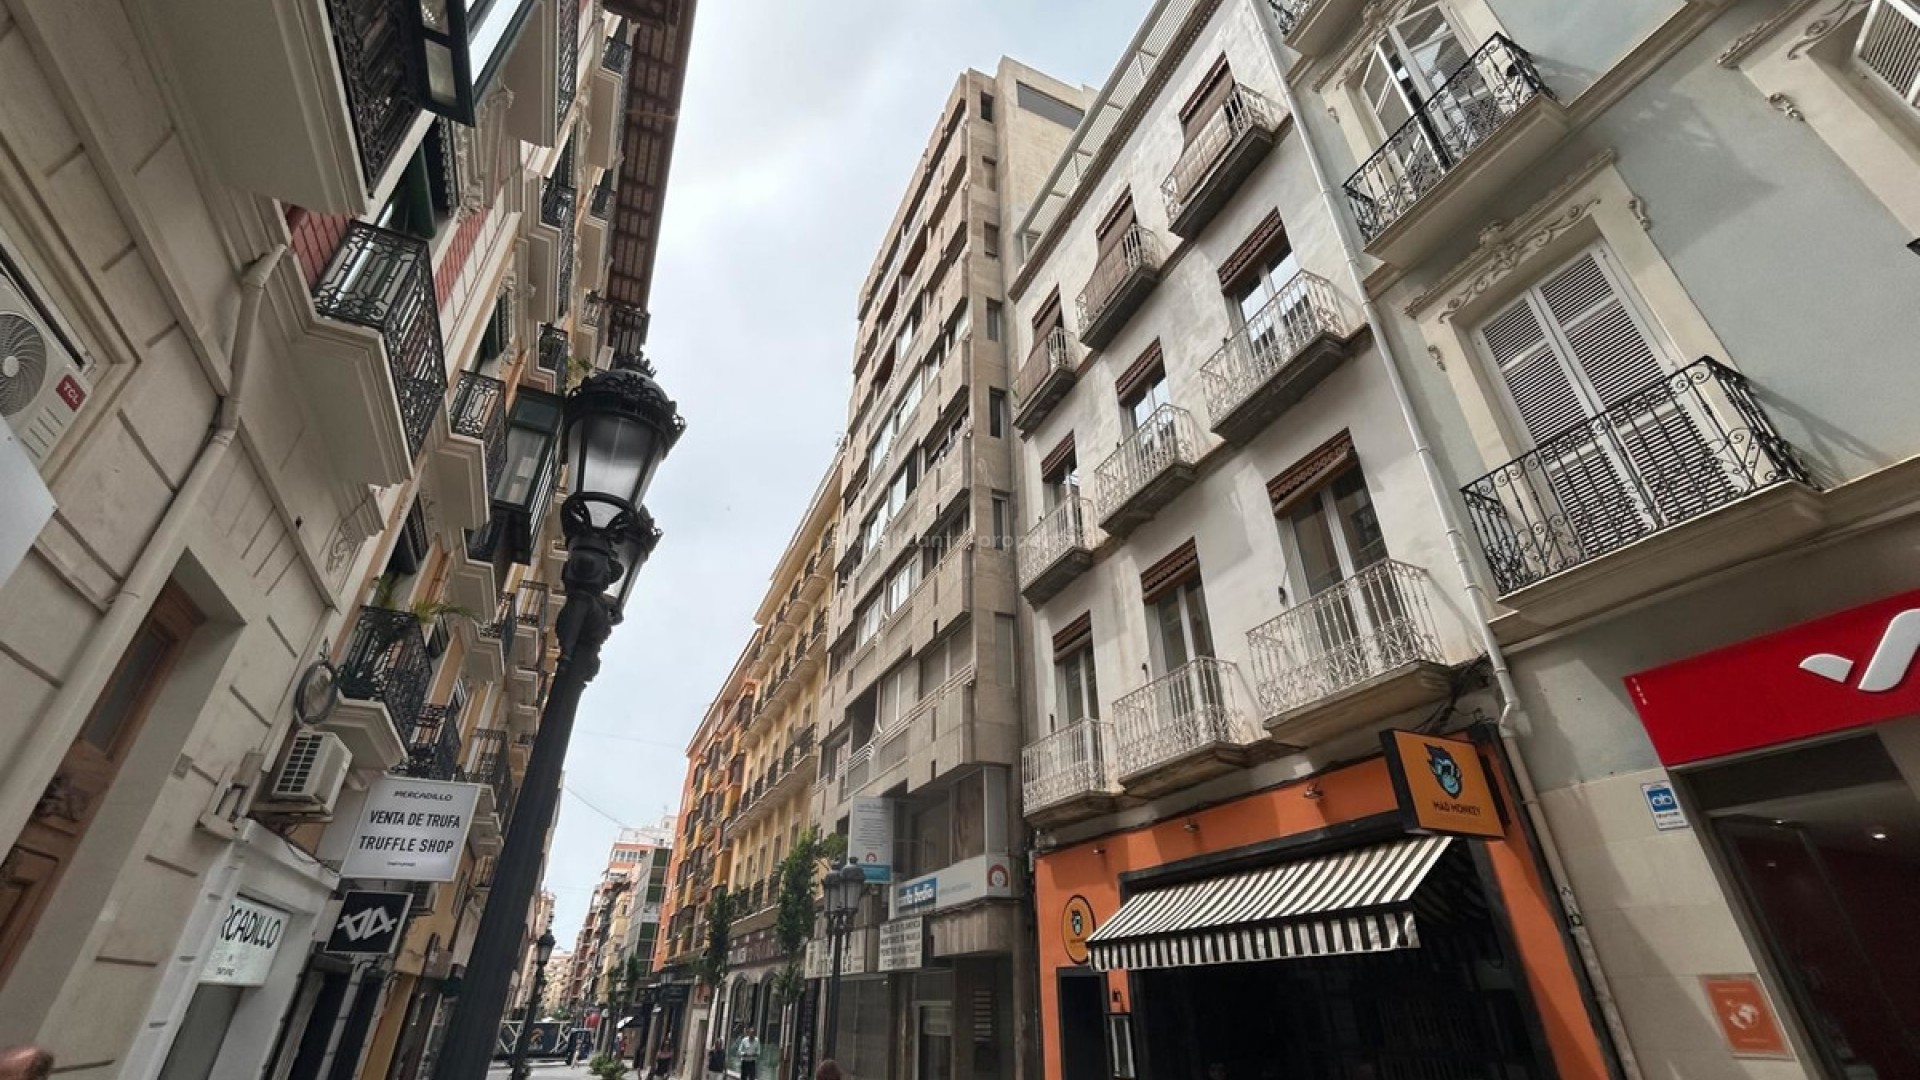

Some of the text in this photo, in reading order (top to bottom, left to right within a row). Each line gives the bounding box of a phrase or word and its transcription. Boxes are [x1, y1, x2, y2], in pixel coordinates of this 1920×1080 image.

[63, 380, 80, 405] TCL
[393, 790, 453, 801] MERCADILLO
[1433, 801, 1481, 816] MAD MONKEY
[370, 810, 460, 828] VENTA DE TRUFA
[359, 835, 454, 853] TRUFFLE SHOP
